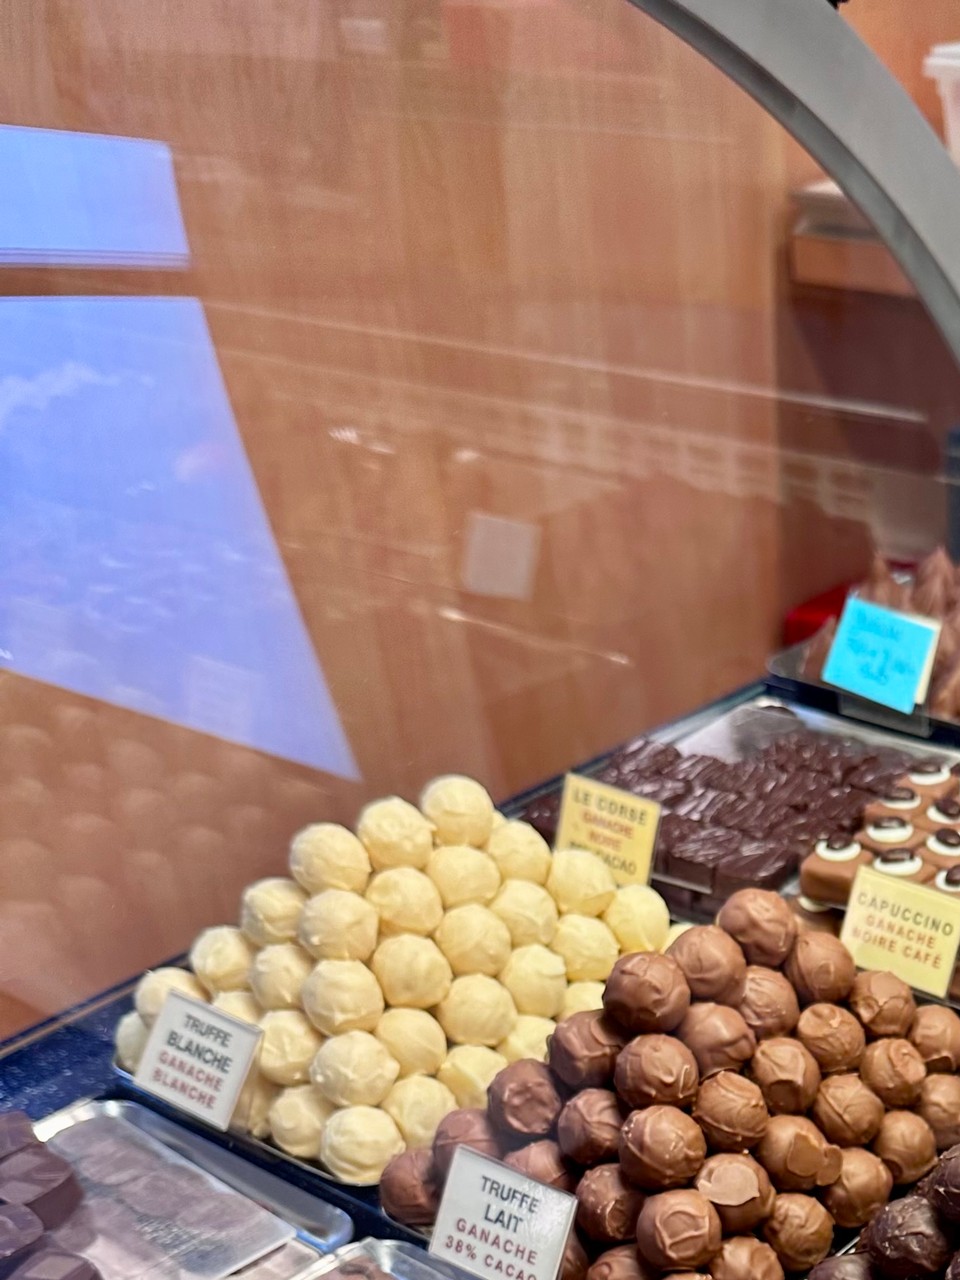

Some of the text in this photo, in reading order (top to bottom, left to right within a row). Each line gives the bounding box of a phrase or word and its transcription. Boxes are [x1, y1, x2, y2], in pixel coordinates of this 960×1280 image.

[857, 893, 954, 936] CAPUCCINO
[865, 915, 937, 949] GANACHE
[852, 926, 943, 970] NOIRE CAFÉ
[184, 1013, 233, 1048] TRUFFE
[159, 1050, 224, 1092] GANACHE
[166, 1030, 233, 1074] BLANCHE
[152, 1067, 217, 1109] BLANCHE
[481, 1175, 540, 1214] TRUFFE
[484, 1203, 524, 1233] LAIT
[445, 1235, 477, 1260] 38%
[456, 1217, 538, 1266] GANACHE
